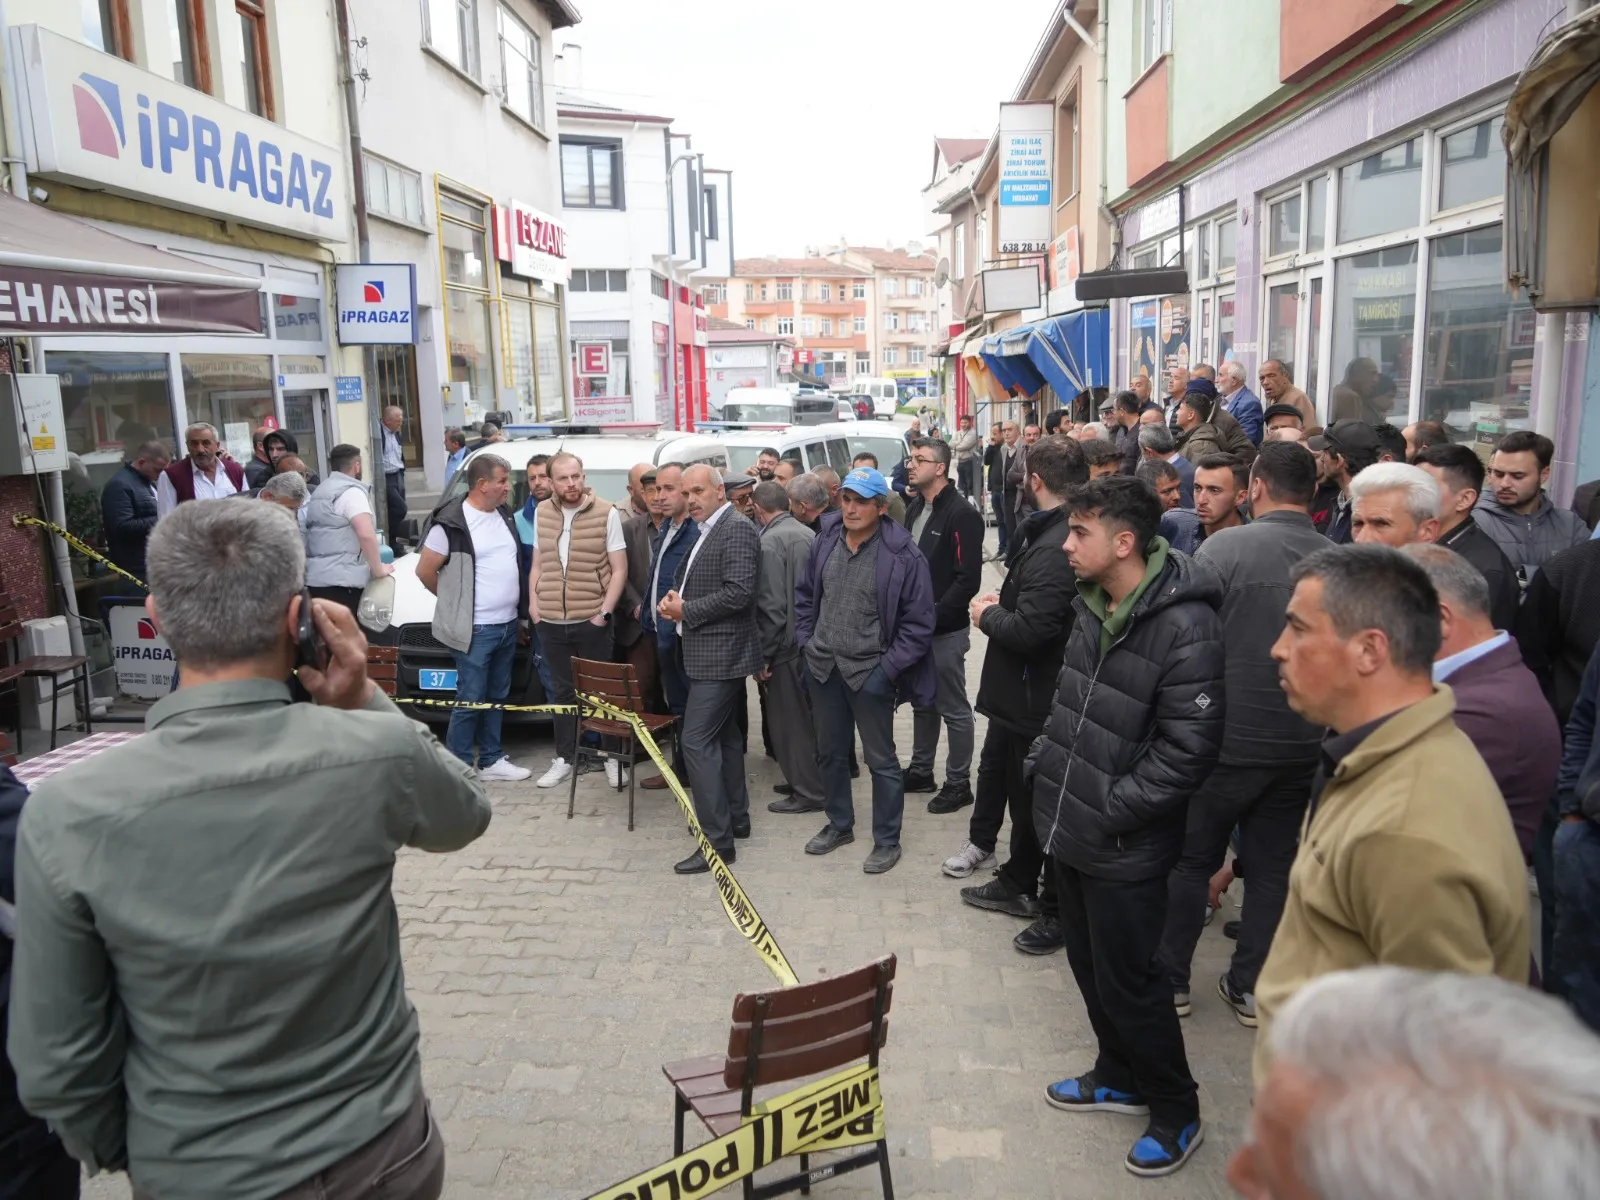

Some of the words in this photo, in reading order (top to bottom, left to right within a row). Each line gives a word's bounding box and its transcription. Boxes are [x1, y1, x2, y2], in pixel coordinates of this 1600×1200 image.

[1003, 243, 1019, 252] 638
[1022, 243, 1032, 252] 28
[1036, 243, 1046, 251] 14
[585, 347, 604, 371] E
[799, 351, 808, 362] E
[430, 672, 446, 687] 37
